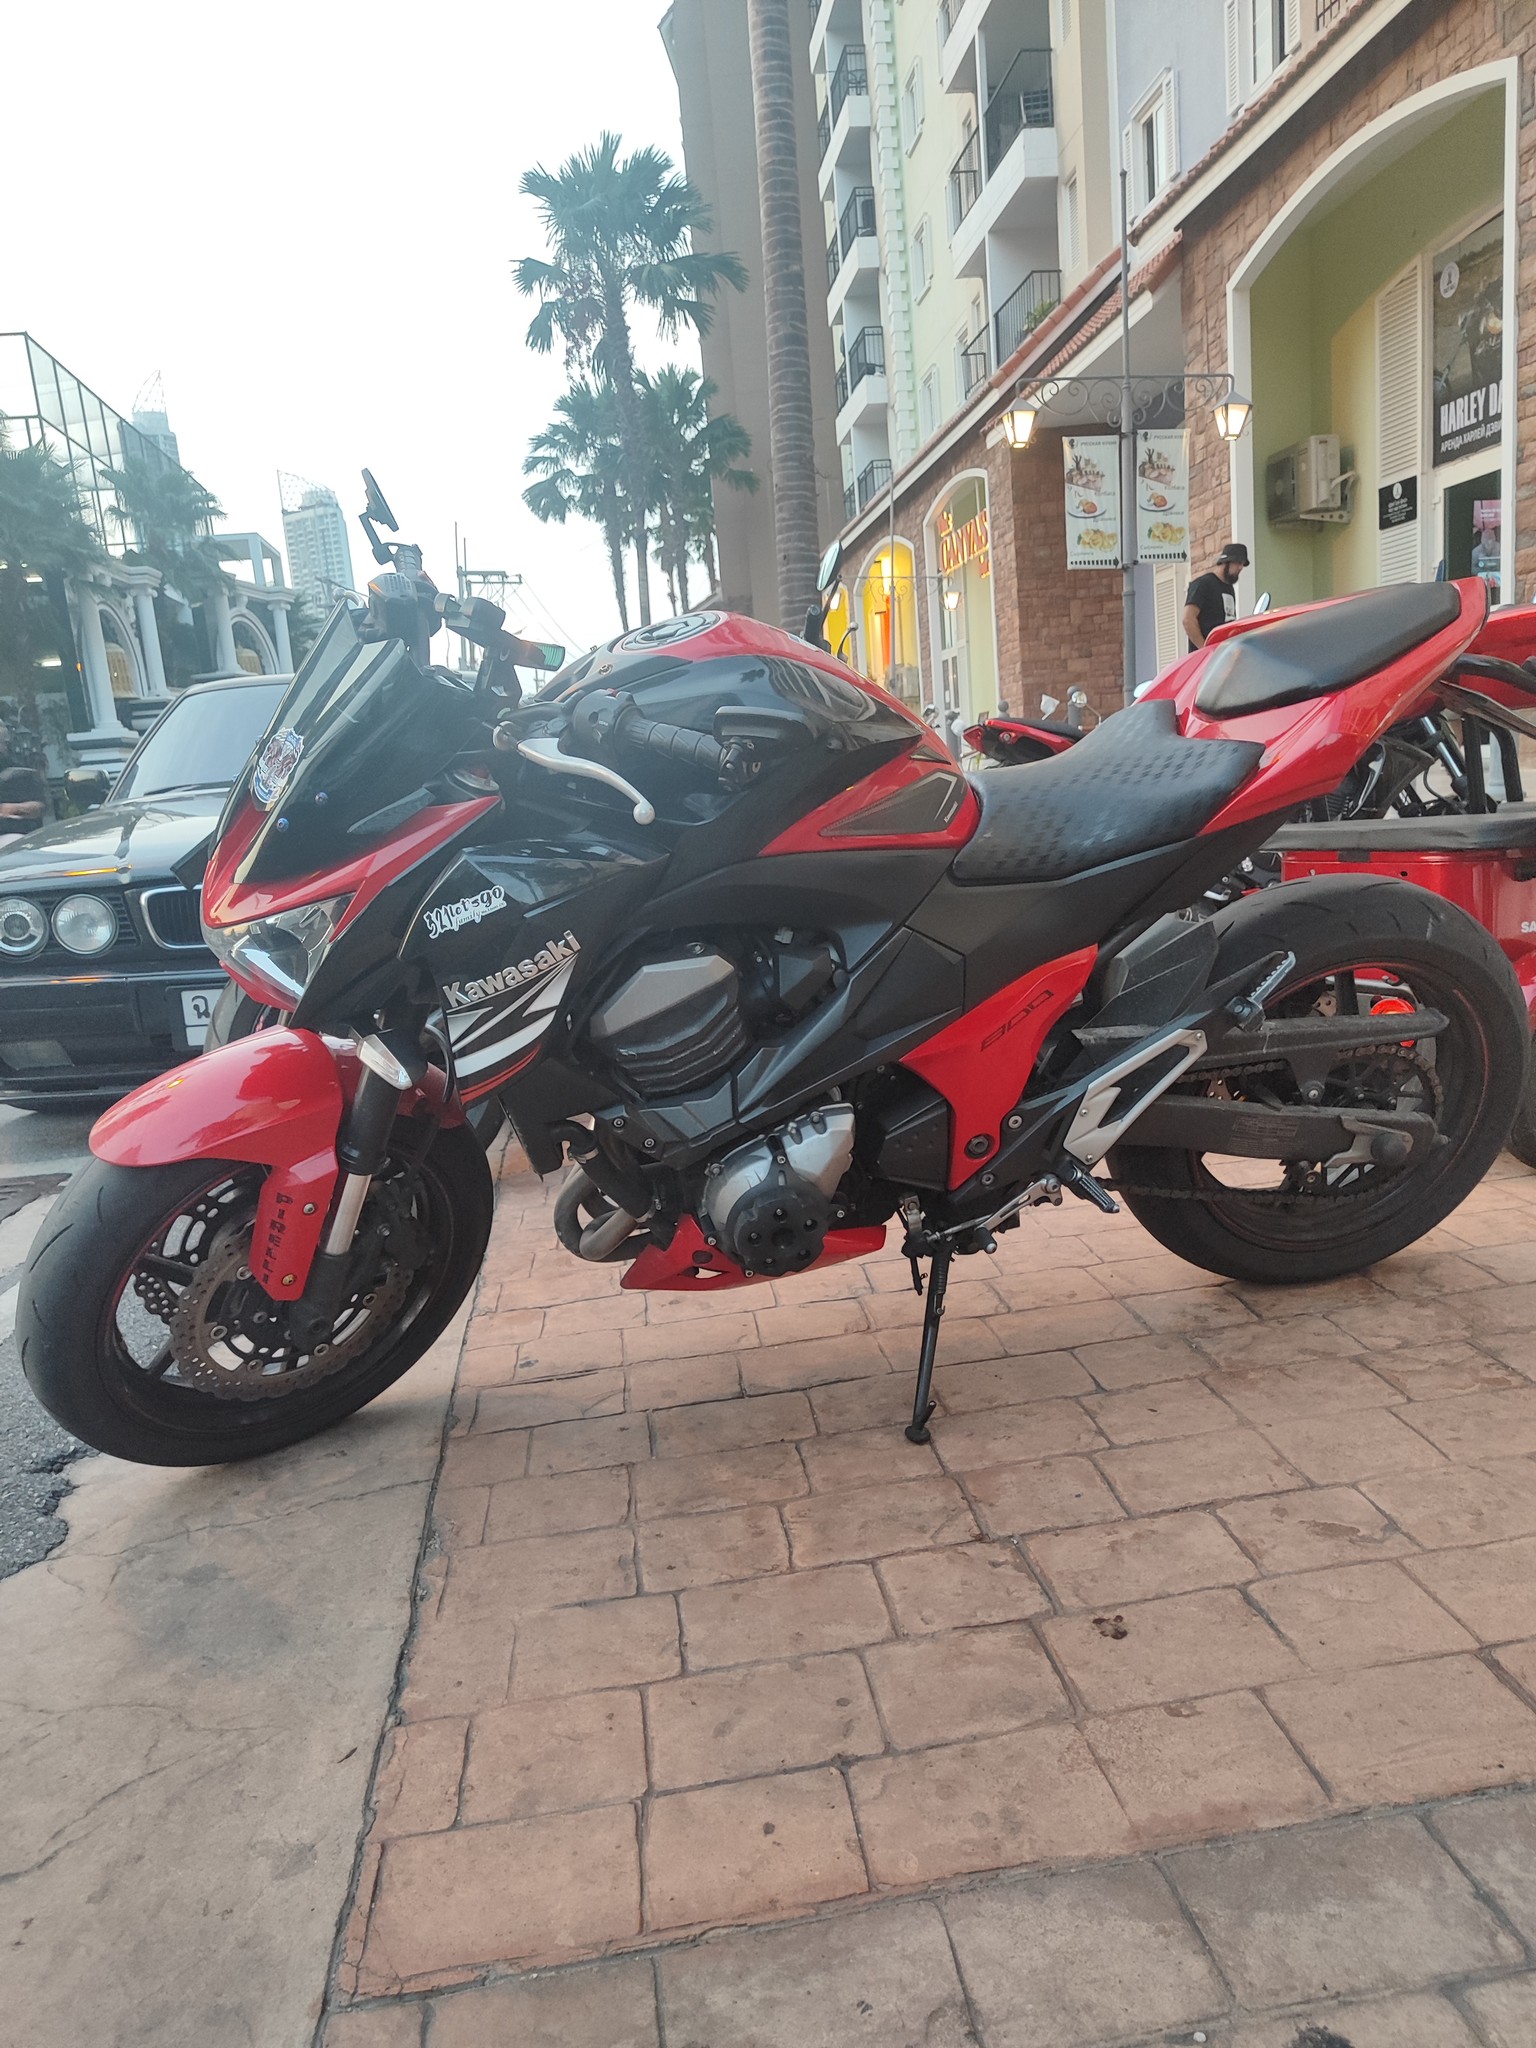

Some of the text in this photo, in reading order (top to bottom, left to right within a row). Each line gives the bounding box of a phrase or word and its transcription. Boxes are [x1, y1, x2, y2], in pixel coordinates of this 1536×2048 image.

[1440, 387, 1486, 437] HARLEY
[442, 929, 582, 1009] Kawasaki
[980, 989, 1055, 1052] 800
[261, 1191, 294, 1285] PIRELLI
